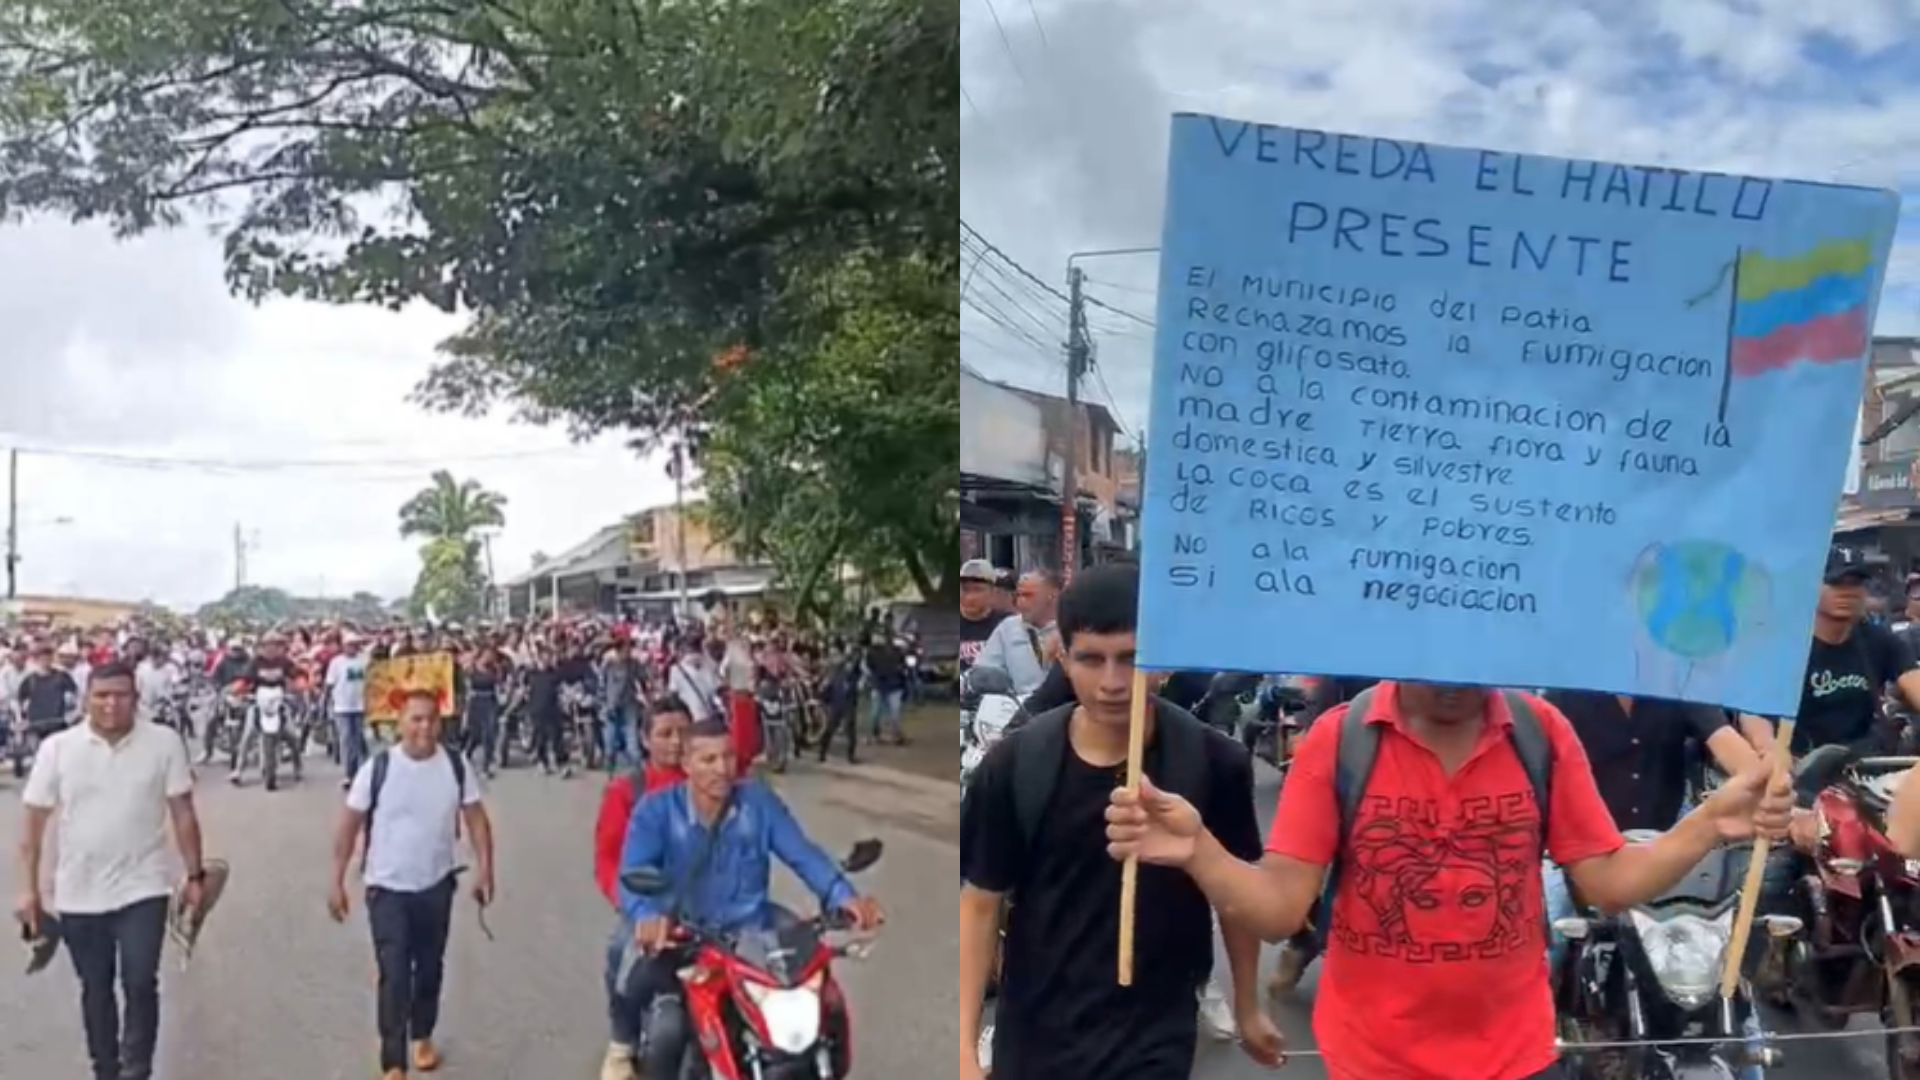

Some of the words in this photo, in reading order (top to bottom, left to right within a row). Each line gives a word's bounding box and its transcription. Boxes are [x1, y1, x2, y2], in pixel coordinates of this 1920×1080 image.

[1208, 115, 1436, 183] VEREDA
[1475, 149, 1535, 196] EL
[1288, 201, 1633, 282] PRESENTE
[1186, 266, 1216, 289] El
[1429, 290, 1475, 322] del
[1183, 331, 1237, 355] con
[1187, 297, 1408, 347] Rechazamos
[1447, 334, 1470, 354] la
[1178, 396, 1314, 431] madre
[1489, 435, 1565, 462] flora
[1583, 445, 1602, 467] y
[1619, 449, 1700, 476] fauna
[1256, 374, 1278, 395] a
[1300, 378, 1325, 401] la
[1351, 385, 1606, 434] contaminacion
[1625, 409, 1673, 442] de
[1172, 423, 1339, 468] domestica
[1356, 451, 1378, 472] y
[1393, 455, 1514, 485] silvestre
[1169, 483, 1209, 514] de
[1228, 467, 1312, 494] coca
[1344, 479, 1385, 501] es
[1406, 487, 1438, 507] el
[1469, 493, 1617, 526] sustento
[1349, 547, 1521, 583] fumigacion
[1363, 578, 1538, 614] negociacion
